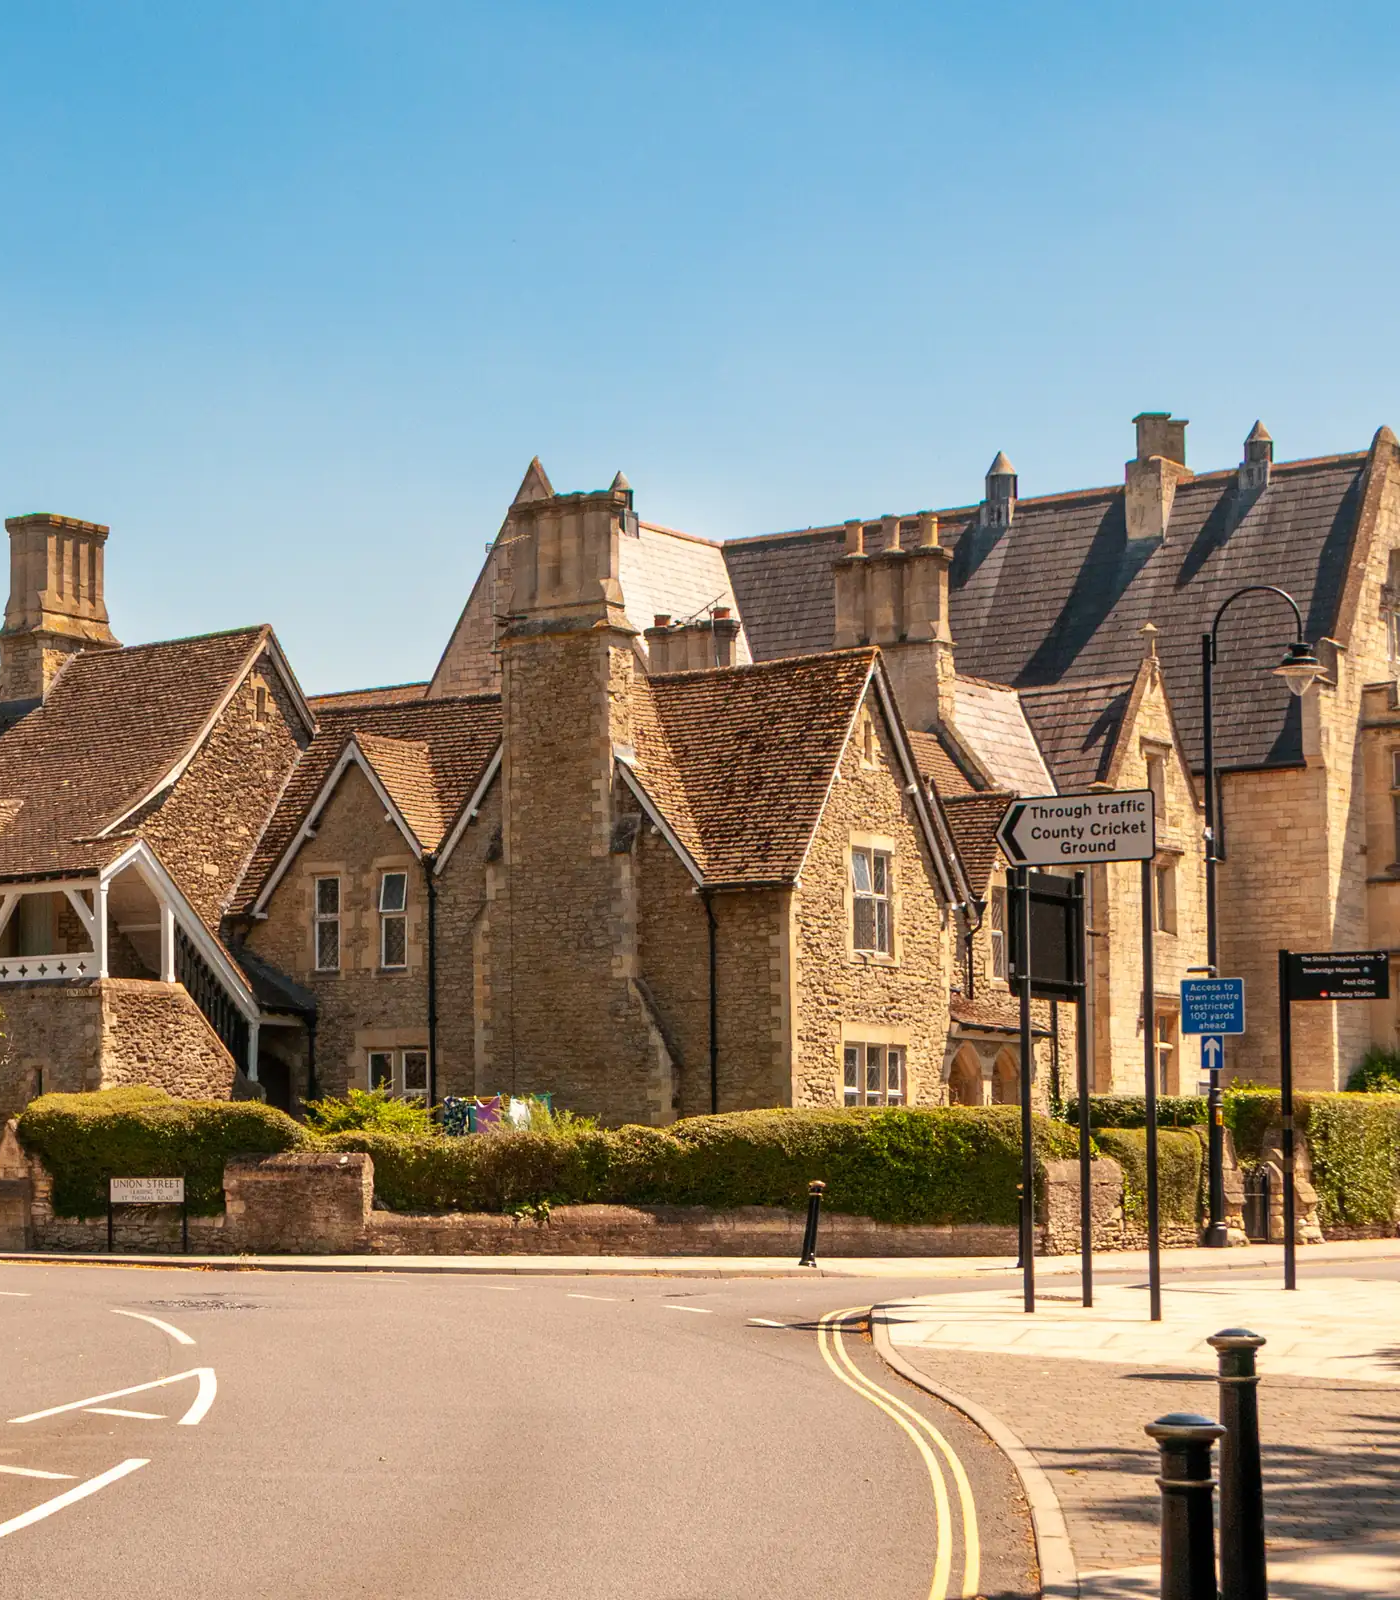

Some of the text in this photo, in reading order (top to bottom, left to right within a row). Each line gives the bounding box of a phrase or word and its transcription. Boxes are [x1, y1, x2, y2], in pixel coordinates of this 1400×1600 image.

[1031, 800, 1145, 819] Through traffic
[1031, 820, 1146, 840] County Cricket
[1060, 839, 1116, 855] Ground
[1302, 967, 1334, 975] Trowbridge
[1190, 1002, 1235, 1010] restricted
[1190, 1012, 1235, 1021] 100 yards
[113, 1180, 181, 1188] UNION STREET
